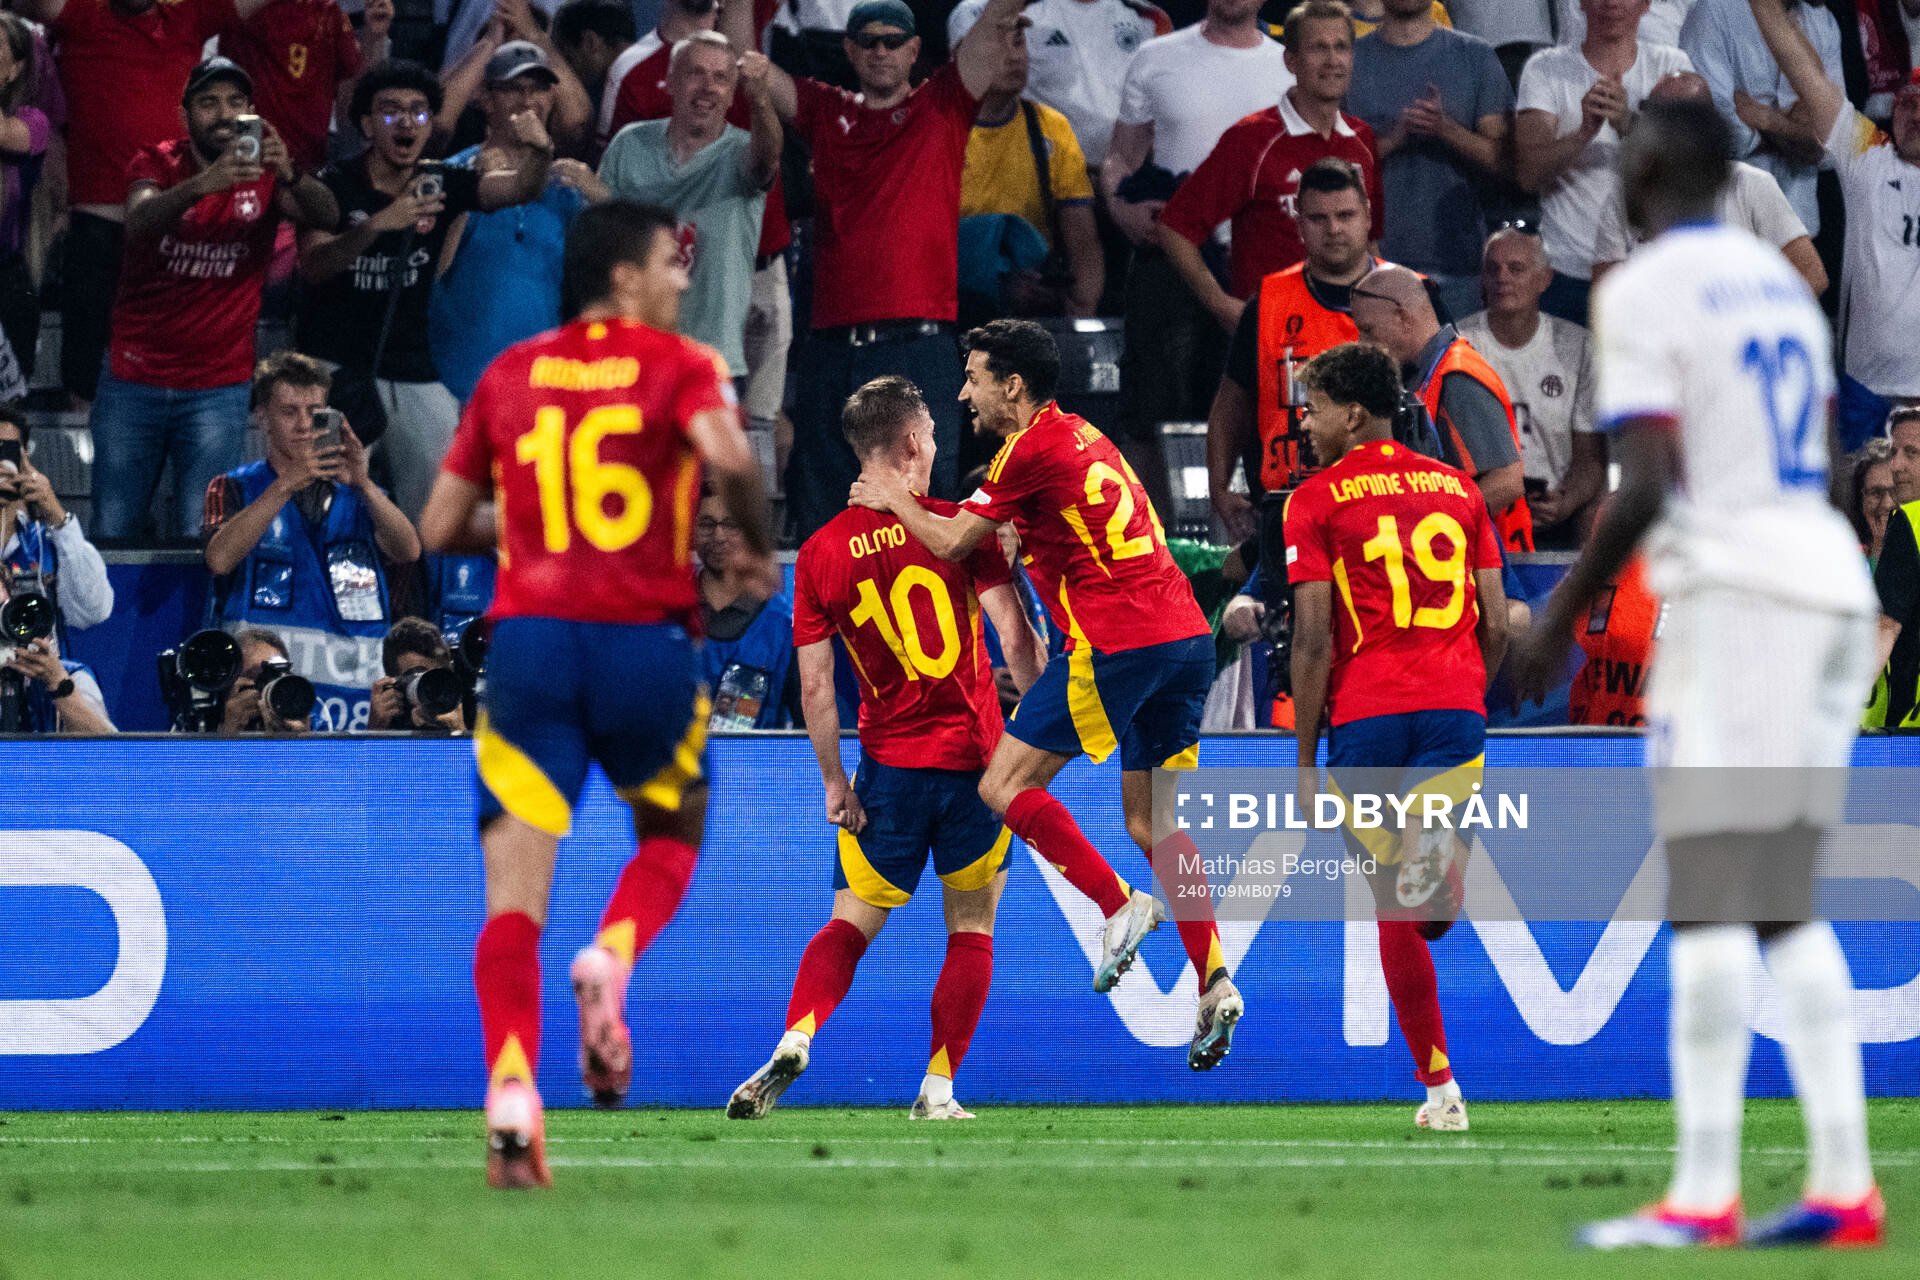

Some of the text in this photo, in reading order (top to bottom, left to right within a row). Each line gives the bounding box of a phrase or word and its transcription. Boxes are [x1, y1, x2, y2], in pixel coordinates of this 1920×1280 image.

[288, 42, 308, 79] 9
[1737, 334, 1830, 487] 12
[515, 403, 653, 553] 16
[1329, 471, 1469, 503] LAMINE YAMAL
[849, 523, 906, 558] OLMO
[1362, 511, 1467, 629] 19
[849, 564, 961, 682] 10
